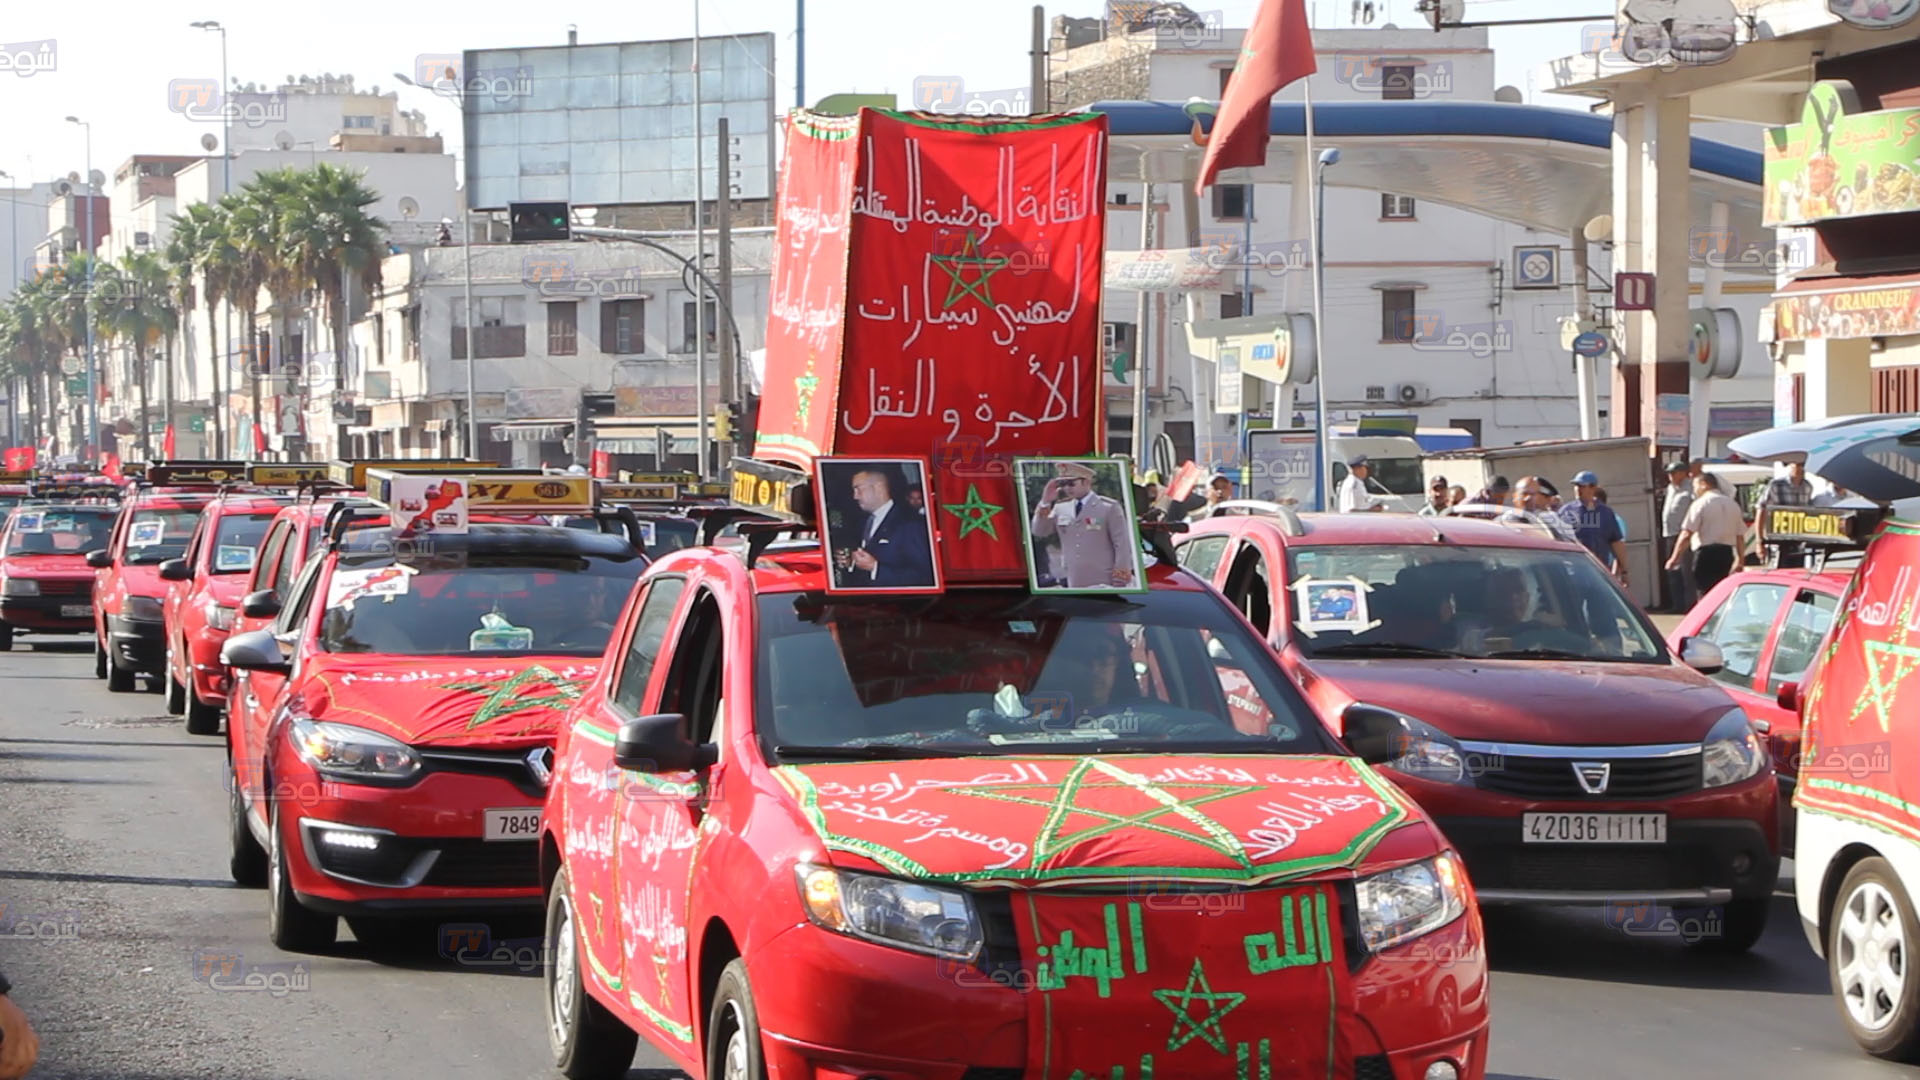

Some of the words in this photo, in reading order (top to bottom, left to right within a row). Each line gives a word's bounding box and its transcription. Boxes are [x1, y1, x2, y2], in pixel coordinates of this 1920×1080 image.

[852, 135, 921, 232] المستقلة
[922, 145, 1014, 246] الوطنية
[1016, 130, 1103, 237] النقابة
[859, 252, 978, 350] سيارات
[843, 358, 936, 434] النقل
[975, 354, 1080, 447] الأجرة
[620, 488, 665, 497] TAXI
[1773, 511, 1806, 534] PETIT
[499, 815, 540, 834] 7849
[1531, 815, 1599, 841] 42036
[1037, 902, 1148, 998] الوطن
[1243, 892, 1332, 975] الله
